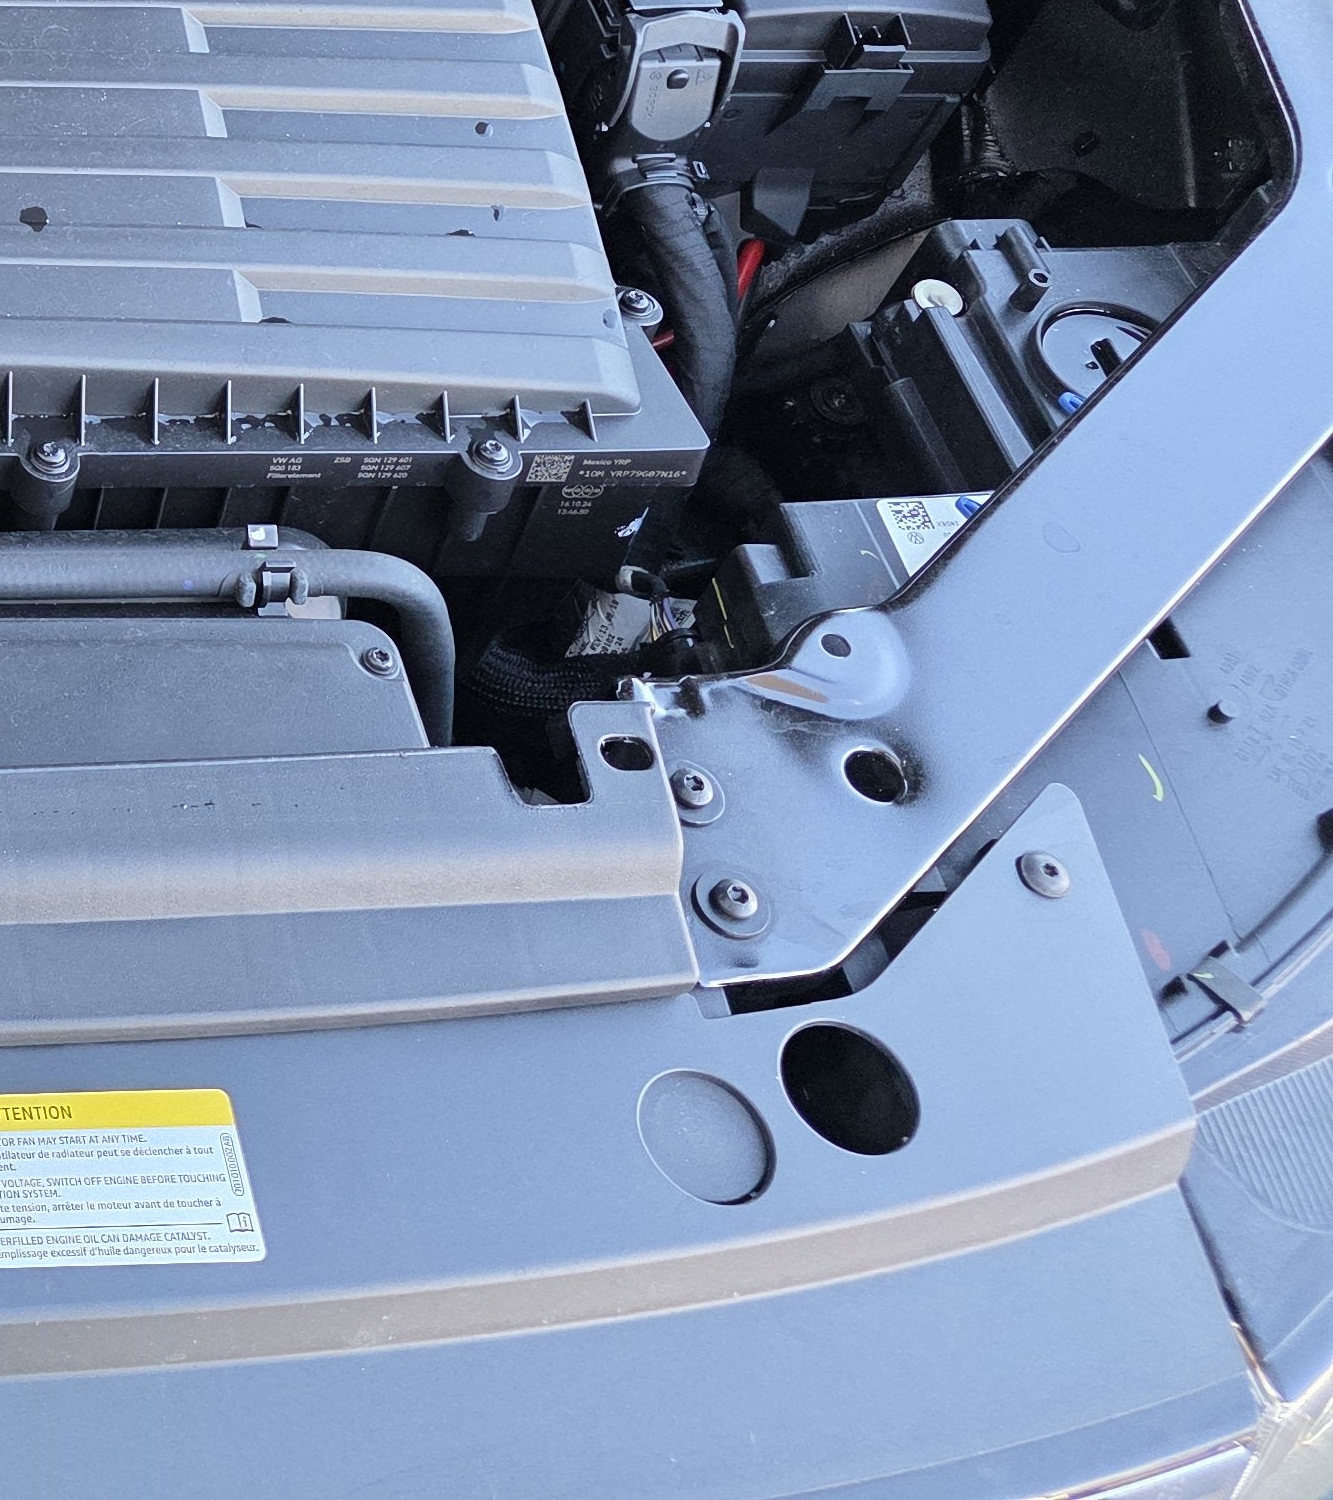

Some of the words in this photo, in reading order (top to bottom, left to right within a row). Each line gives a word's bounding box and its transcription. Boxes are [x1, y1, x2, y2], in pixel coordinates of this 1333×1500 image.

[383, 456, 398, 464] 129
[614, 458, 632, 466] YRP
[16, 1137, 36, 1146] FAN
[37, 1136, 57, 1146] MAY
[58, 1135, 87, 1145] START
[88, 1135, 99, 1144] AT
[101, 1134, 120, 1144] ANY
[121, 1133, 148, 1143] TIME.
[37, 1149, 50, 1159] de
[51, 1148, 94, 1159] radiateur
[96, 1148, 120, 1160] peut
[120, 1149, 131, 1157] se
[132, 1146, 184, 1156] déclencher
[185, 1145, 192, 1155] à
[193, 1146, 214, 1155] tout
[0, 1178, 45, 1188] VOLTAGE,
[46, 1177, 82, 1187] SWITCH
[83, 1176, 102, 1186] OFF
[103, 1175, 140, 1186] ENGINE
[140, 1174, 178, 1185] BEFORE
[177, 1173, 227, 1183] TOUCHING
[22, 1189, 62, 1199] SYSTEM.
[45, 1234, 82, 1245] ENGINE
[83, 1234, 100, 1244] OIL
[100, 1233, 120, 1244] CAN
[121, 1232, 164, 1243] DAMAGE
[163, 1231, 211, 1242] CATALYST.
